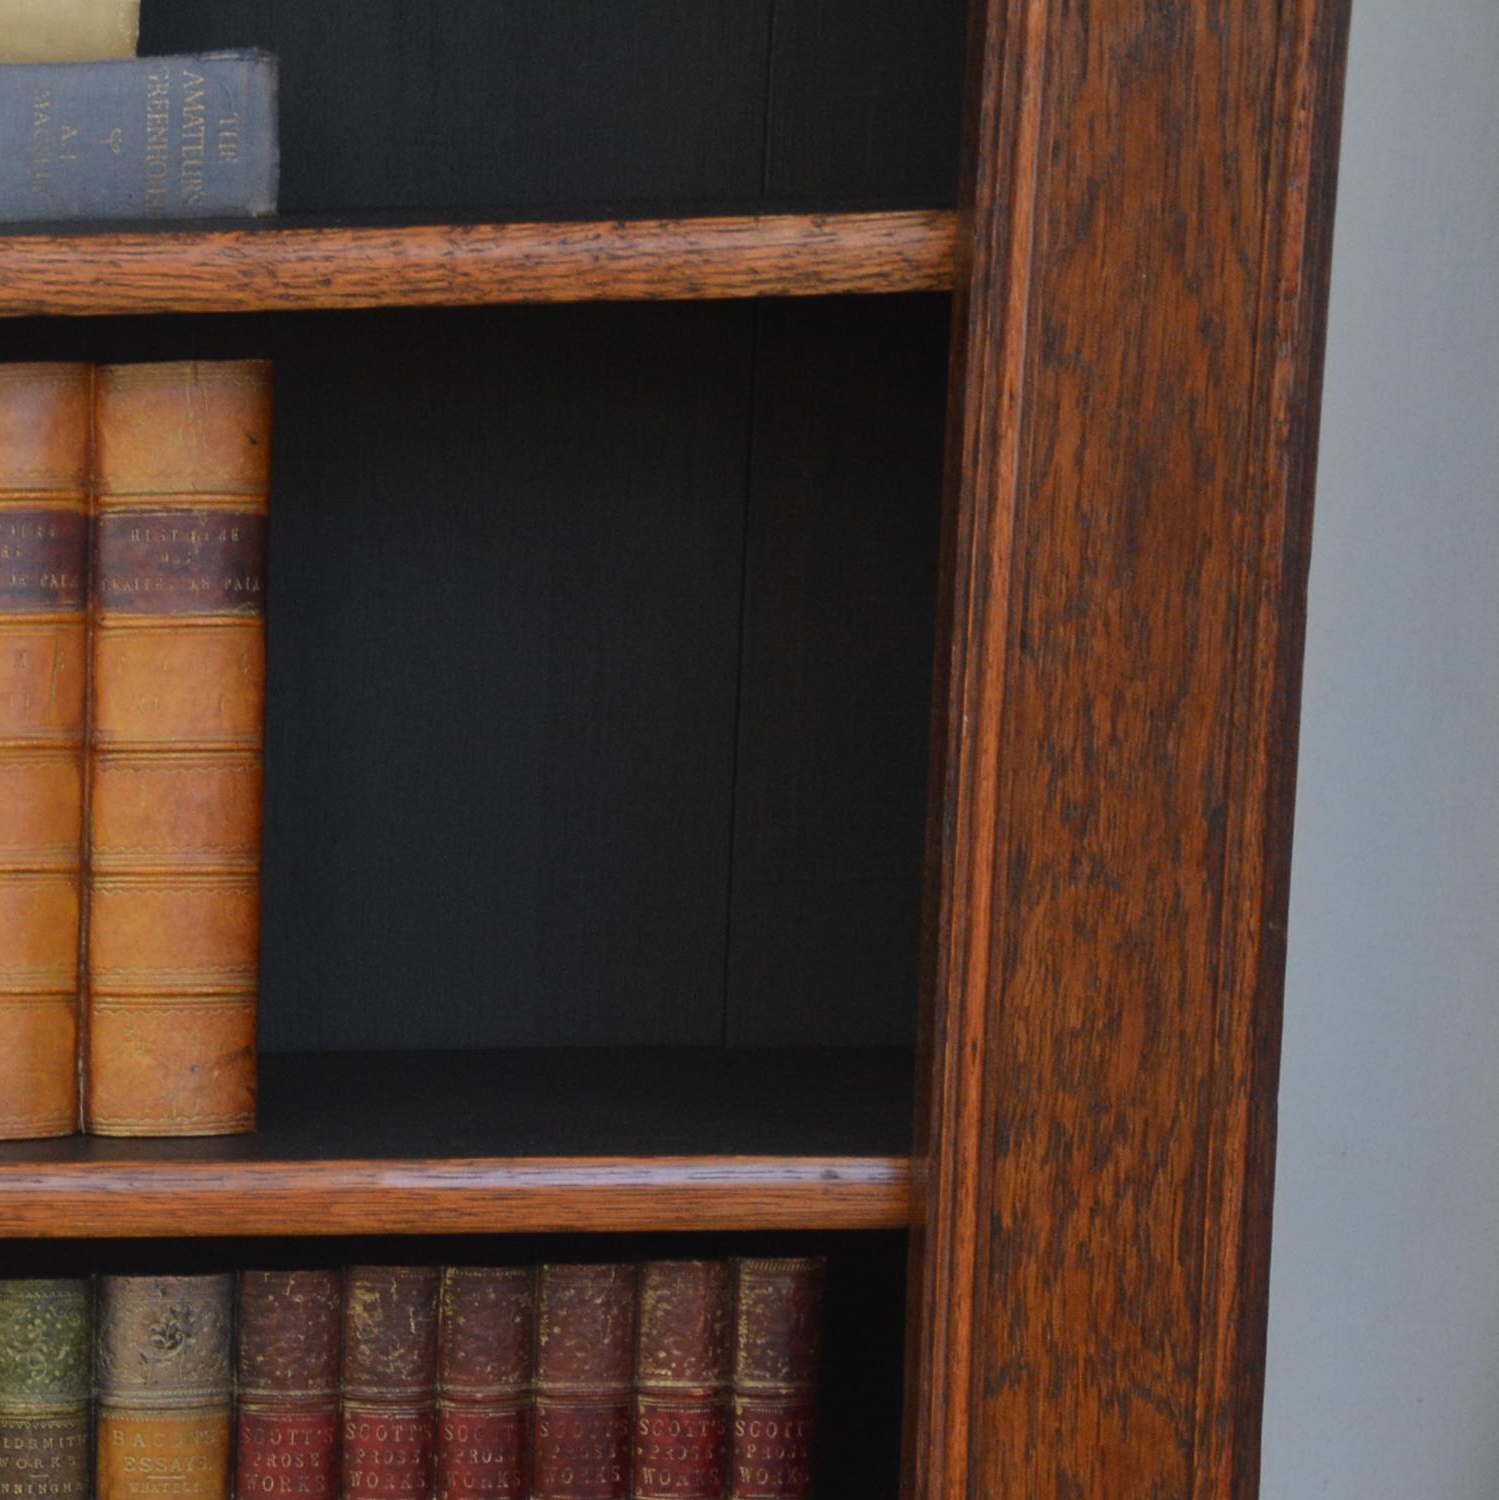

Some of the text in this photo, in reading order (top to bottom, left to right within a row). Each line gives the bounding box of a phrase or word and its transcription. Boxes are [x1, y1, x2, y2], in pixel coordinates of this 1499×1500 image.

[242, 1426, 334, 1447] SCOTT'S
[344, 1422, 433, 1443] SCOTT'S
[251, 1451, 320, 1470] PROSE
[355, 1448, 421, 1465] PROSE
[649, 1443, 714, 1462] PROSE
[245, 1474, 326, 1494] WORKS
[348, 1469, 426, 1490] WORKS
